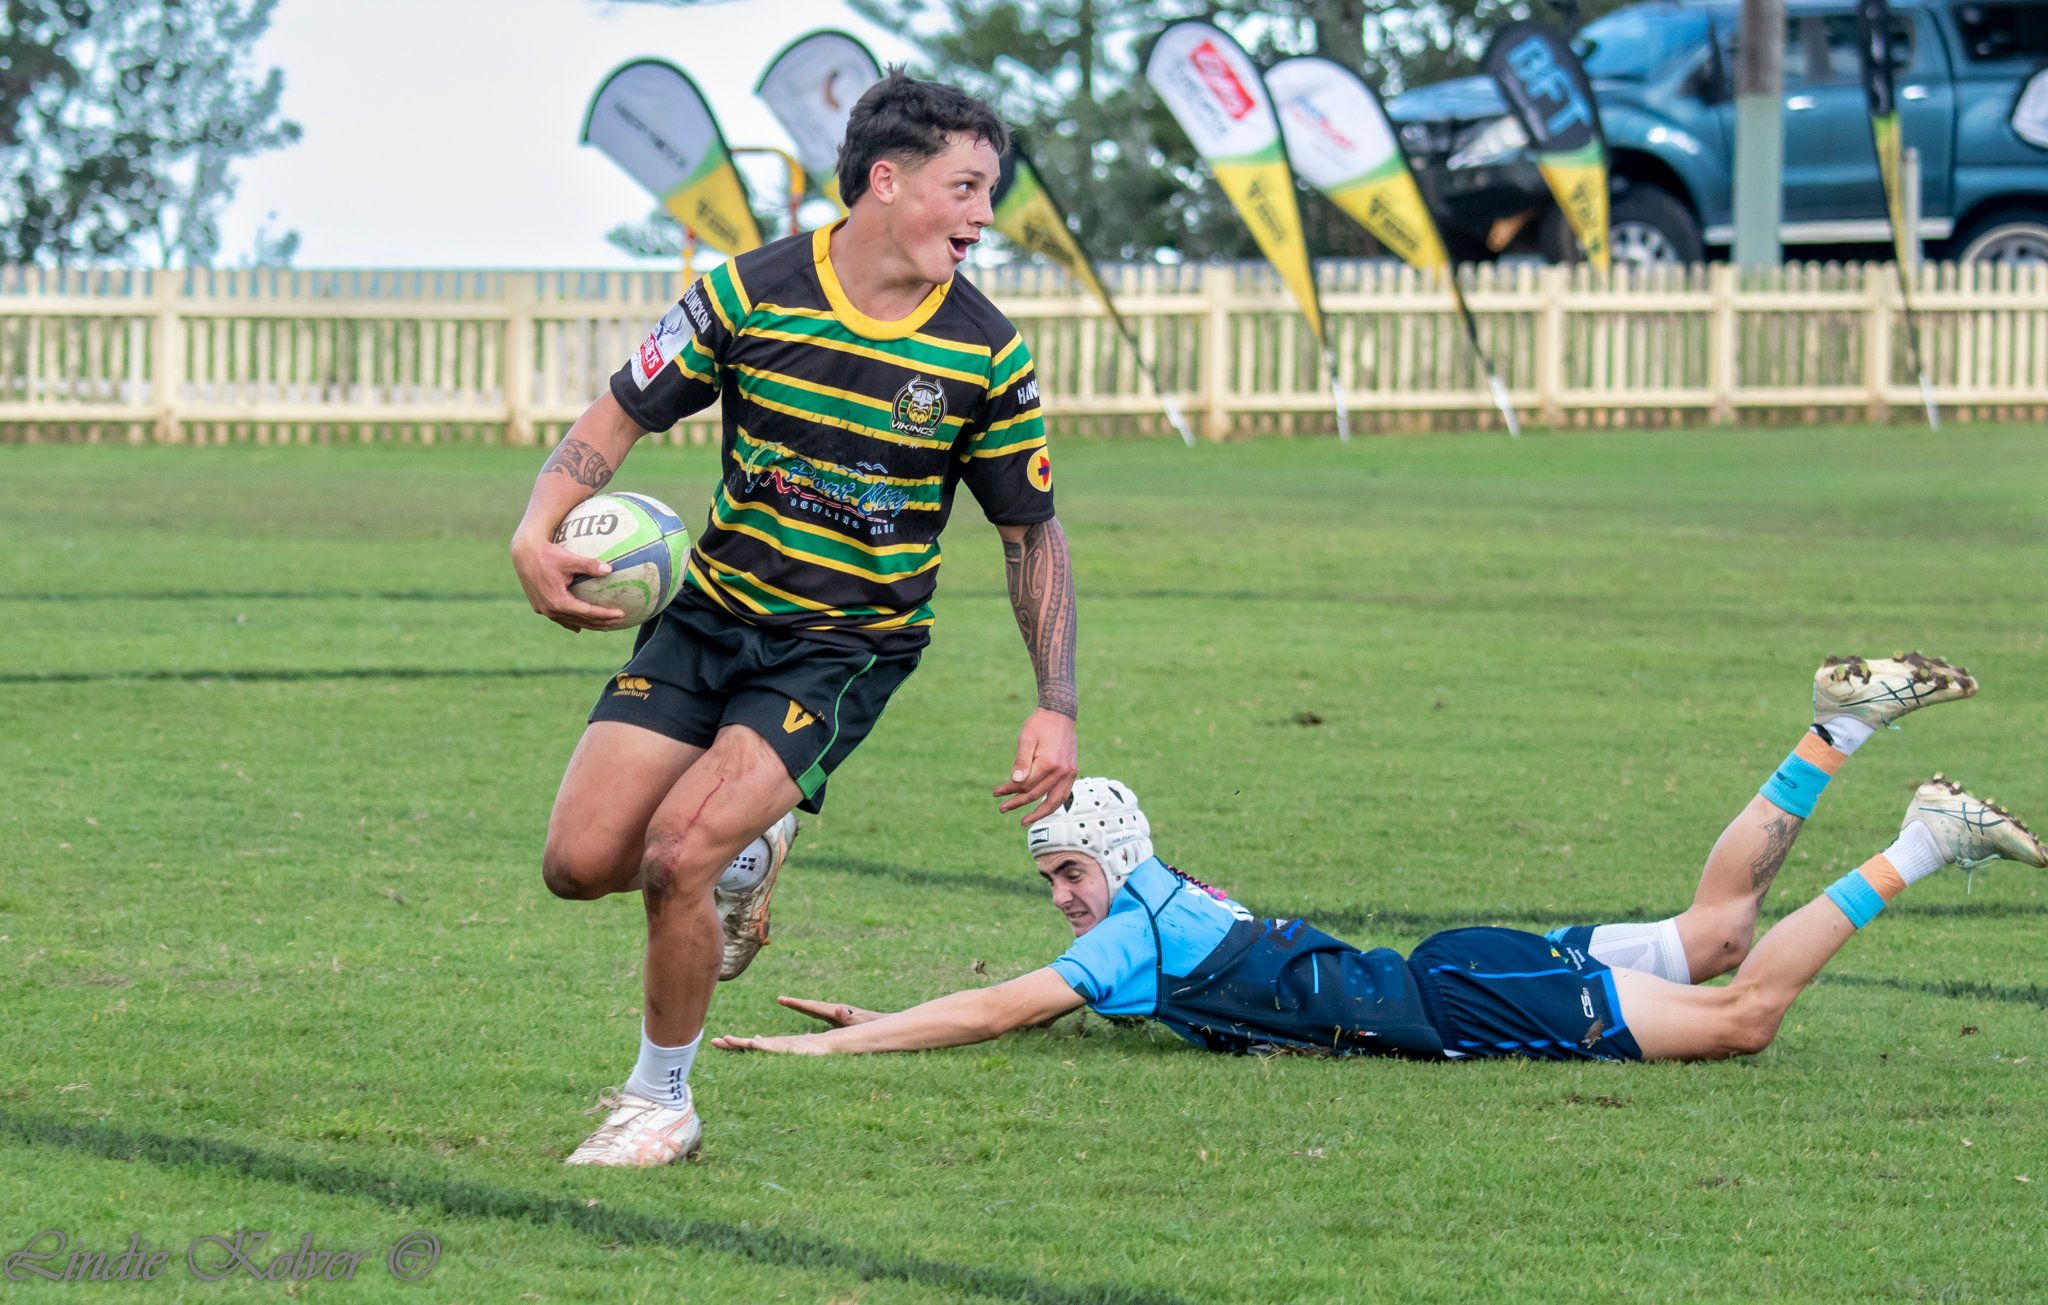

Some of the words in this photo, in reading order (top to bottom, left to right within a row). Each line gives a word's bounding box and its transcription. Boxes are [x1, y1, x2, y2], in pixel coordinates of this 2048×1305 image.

[1505, 34, 1592, 136] BFT
[891, 419, 937, 437] VIKINGS
[857, 481, 909, 517] City
[782, 699, 815, 734] V
